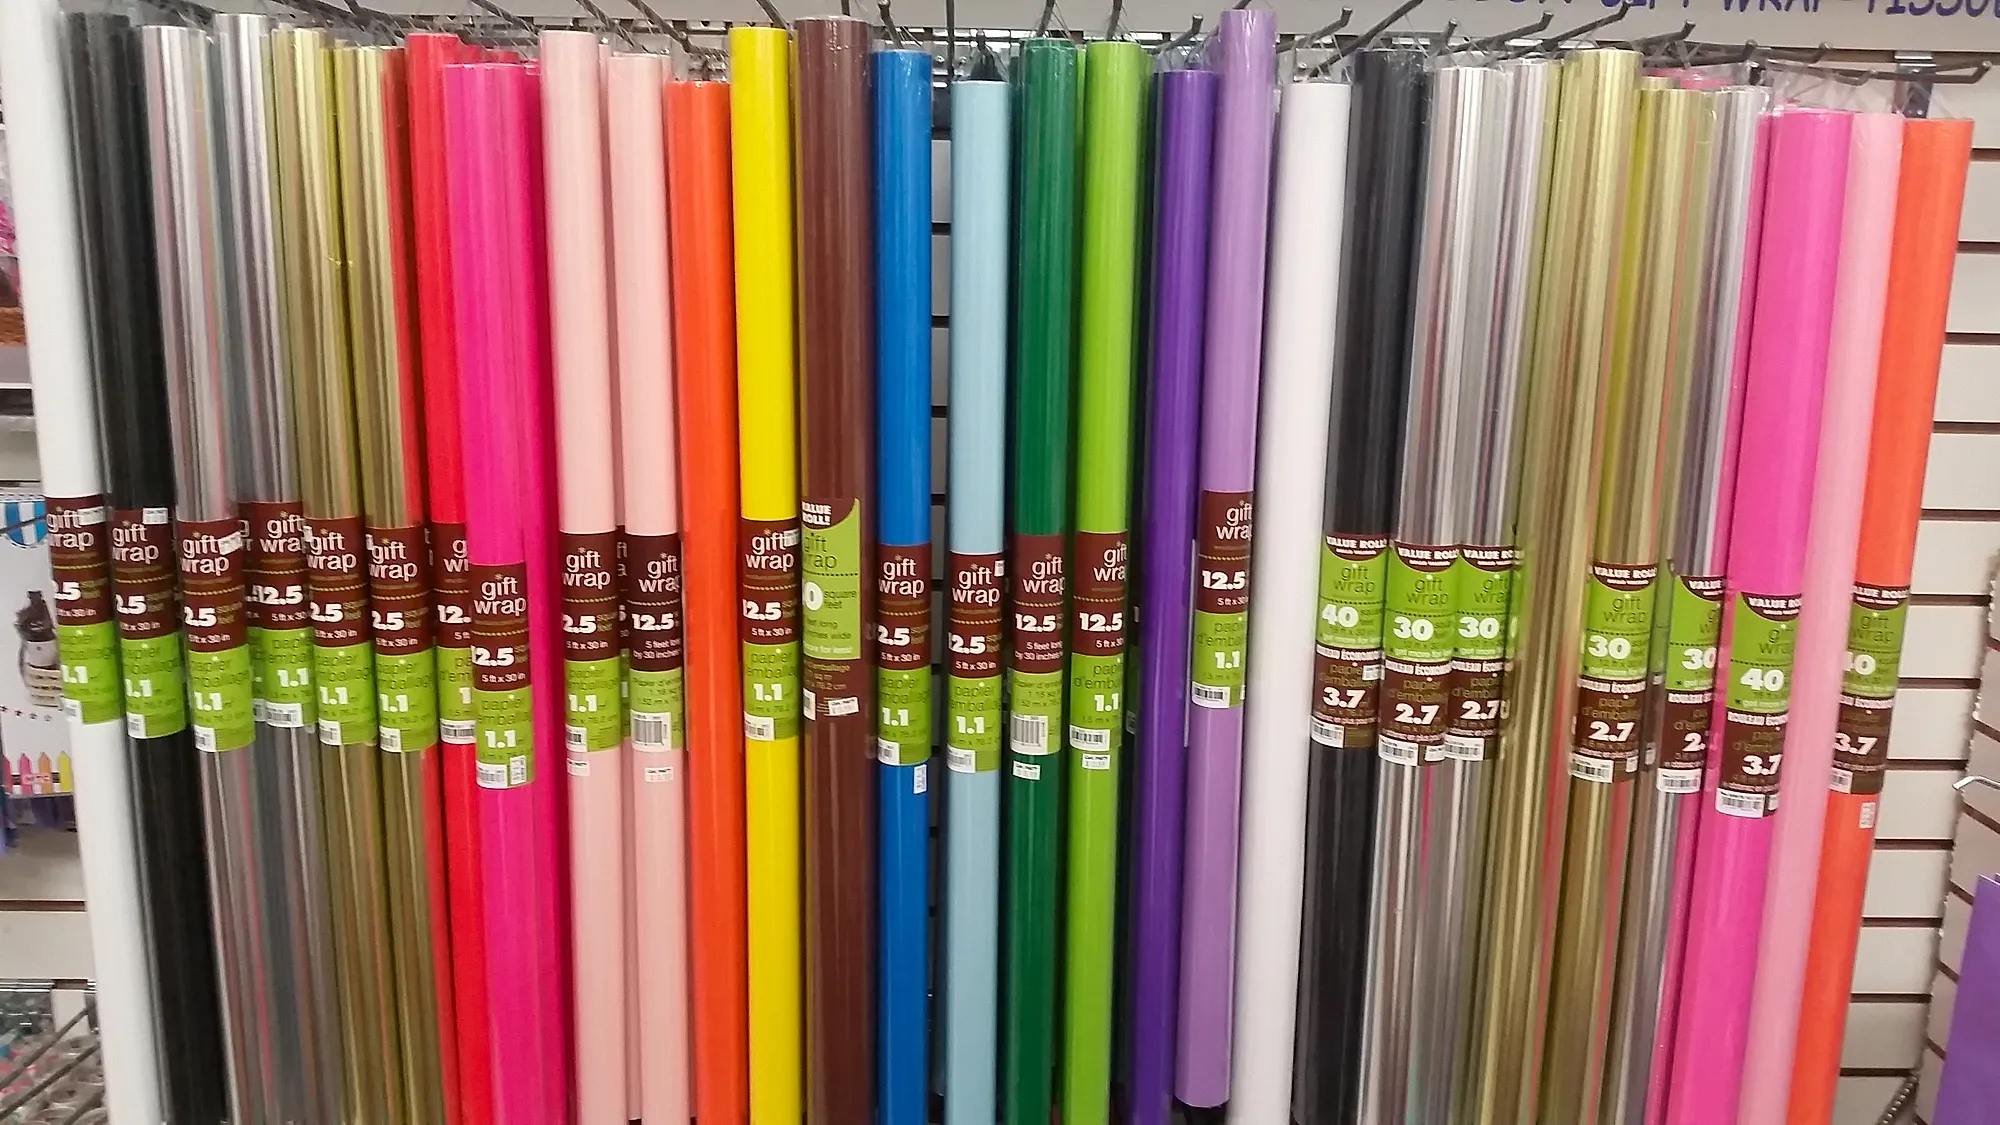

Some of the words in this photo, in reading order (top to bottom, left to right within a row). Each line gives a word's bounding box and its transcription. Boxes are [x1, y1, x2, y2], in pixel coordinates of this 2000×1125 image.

[112, 521, 147, 547] gift
[267, 511, 304, 538] gift
[182, 532, 219, 558] gift
[310, 529, 345, 555] gift
[372, 538, 407, 564] gift
[752, 529, 786, 555] gift
[1326, 536, 1357, 548] VALUE
[566, 547, 601, 573] gift
[745, 553, 794, 572] wrap
[804, 553, 837, 572] rap
[1397, 547, 1432, 560] VALUE
[1463, 549, 1499, 560] VALUE
[647, 552, 678, 579] gift
[883, 555, 916, 580] gift
[1032, 554, 1063, 579] gift
[1341, 564, 1369, 581] gift
[1594, 566, 1631, 578] VALUE
[562, 571, 611, 590] wrap
[958, 564, 992, 589] gift
[1202, 570, 1246, 590] 12.5
[1414, 574, 1443, 593] gift
[482, 574, 518, 600] gift
[878, 579, 924, 598] wrap
[1333, 581, 1376, 595] wrap
[952, 587, 1000, 607] wrap
[1217, 596, 1224, 606] 5
[1406, 592, 1448, 606] wrap
[1612, 594, 1641, 612] gift
[1748, 597, 1787, 608] VALUE
[474, 597, 526, 617] wrap
[1322, 603, 1359, 628] 40
[631, 612, 674, 631] 12.5
[1015, 613, 1056, 632] 12.5
[1079, 612, 1123, 632] 12.5
[1604, 611, 1646, 624] wrap
[752, 628, 757, 636] 5
[772, 628, 784, 636] 30
[1393, 616, 1434, 642] 30
[1458, 616, 1500, 639] 30
[586, 641, 599, 650] 30
[645, 638, 652, 649] 5
[1026, 641, 1033, 650] 5
[1096, 638, 1102, 648] 5
[1588, 635, 1631, 660] 30
[881, 653, 887, 662] 5
[900, 653, 912, 662] 30
[955, 661, 961, 670] 5
[976, 661, 988, 670] 30
[988, 661, 997, 670] in
[1214, 650, 1241, 669] 1.1
[1681, 647, 1717, 670] 30
[277, 668, 309, 687] 1.1
[482, 673, 488, 683] 5
[505, 673, 517, 683] 30
[1740, 667, 1785, 692] 40
[125, 679, 152, 698] 1.1
[320, 686, 348, 705] 1.1
[753, 683, 783, 701] 1.1
[1322, 686, 1366, 709] 3.7
[194, 692, 223, 711] 1.1
[379, 693, 408, 712] 1.1
[568, 694, 598, 712] 1.1
[1094, 693, 1119, 712] 1.1
[1460, 700, 1500, 720] 2.7
[882, 707, 909, 726] 1.1
[1394, 703, 1440, 725] 2.7
[956, 716, 985, 734] 1.1
[1588, 721, 1635, 742] 2.7
[484, 729, 516, 748] 1.1
[1834, 732, 1878, 756] 3.7
[1741, 754, 1783, 775] 3.7
